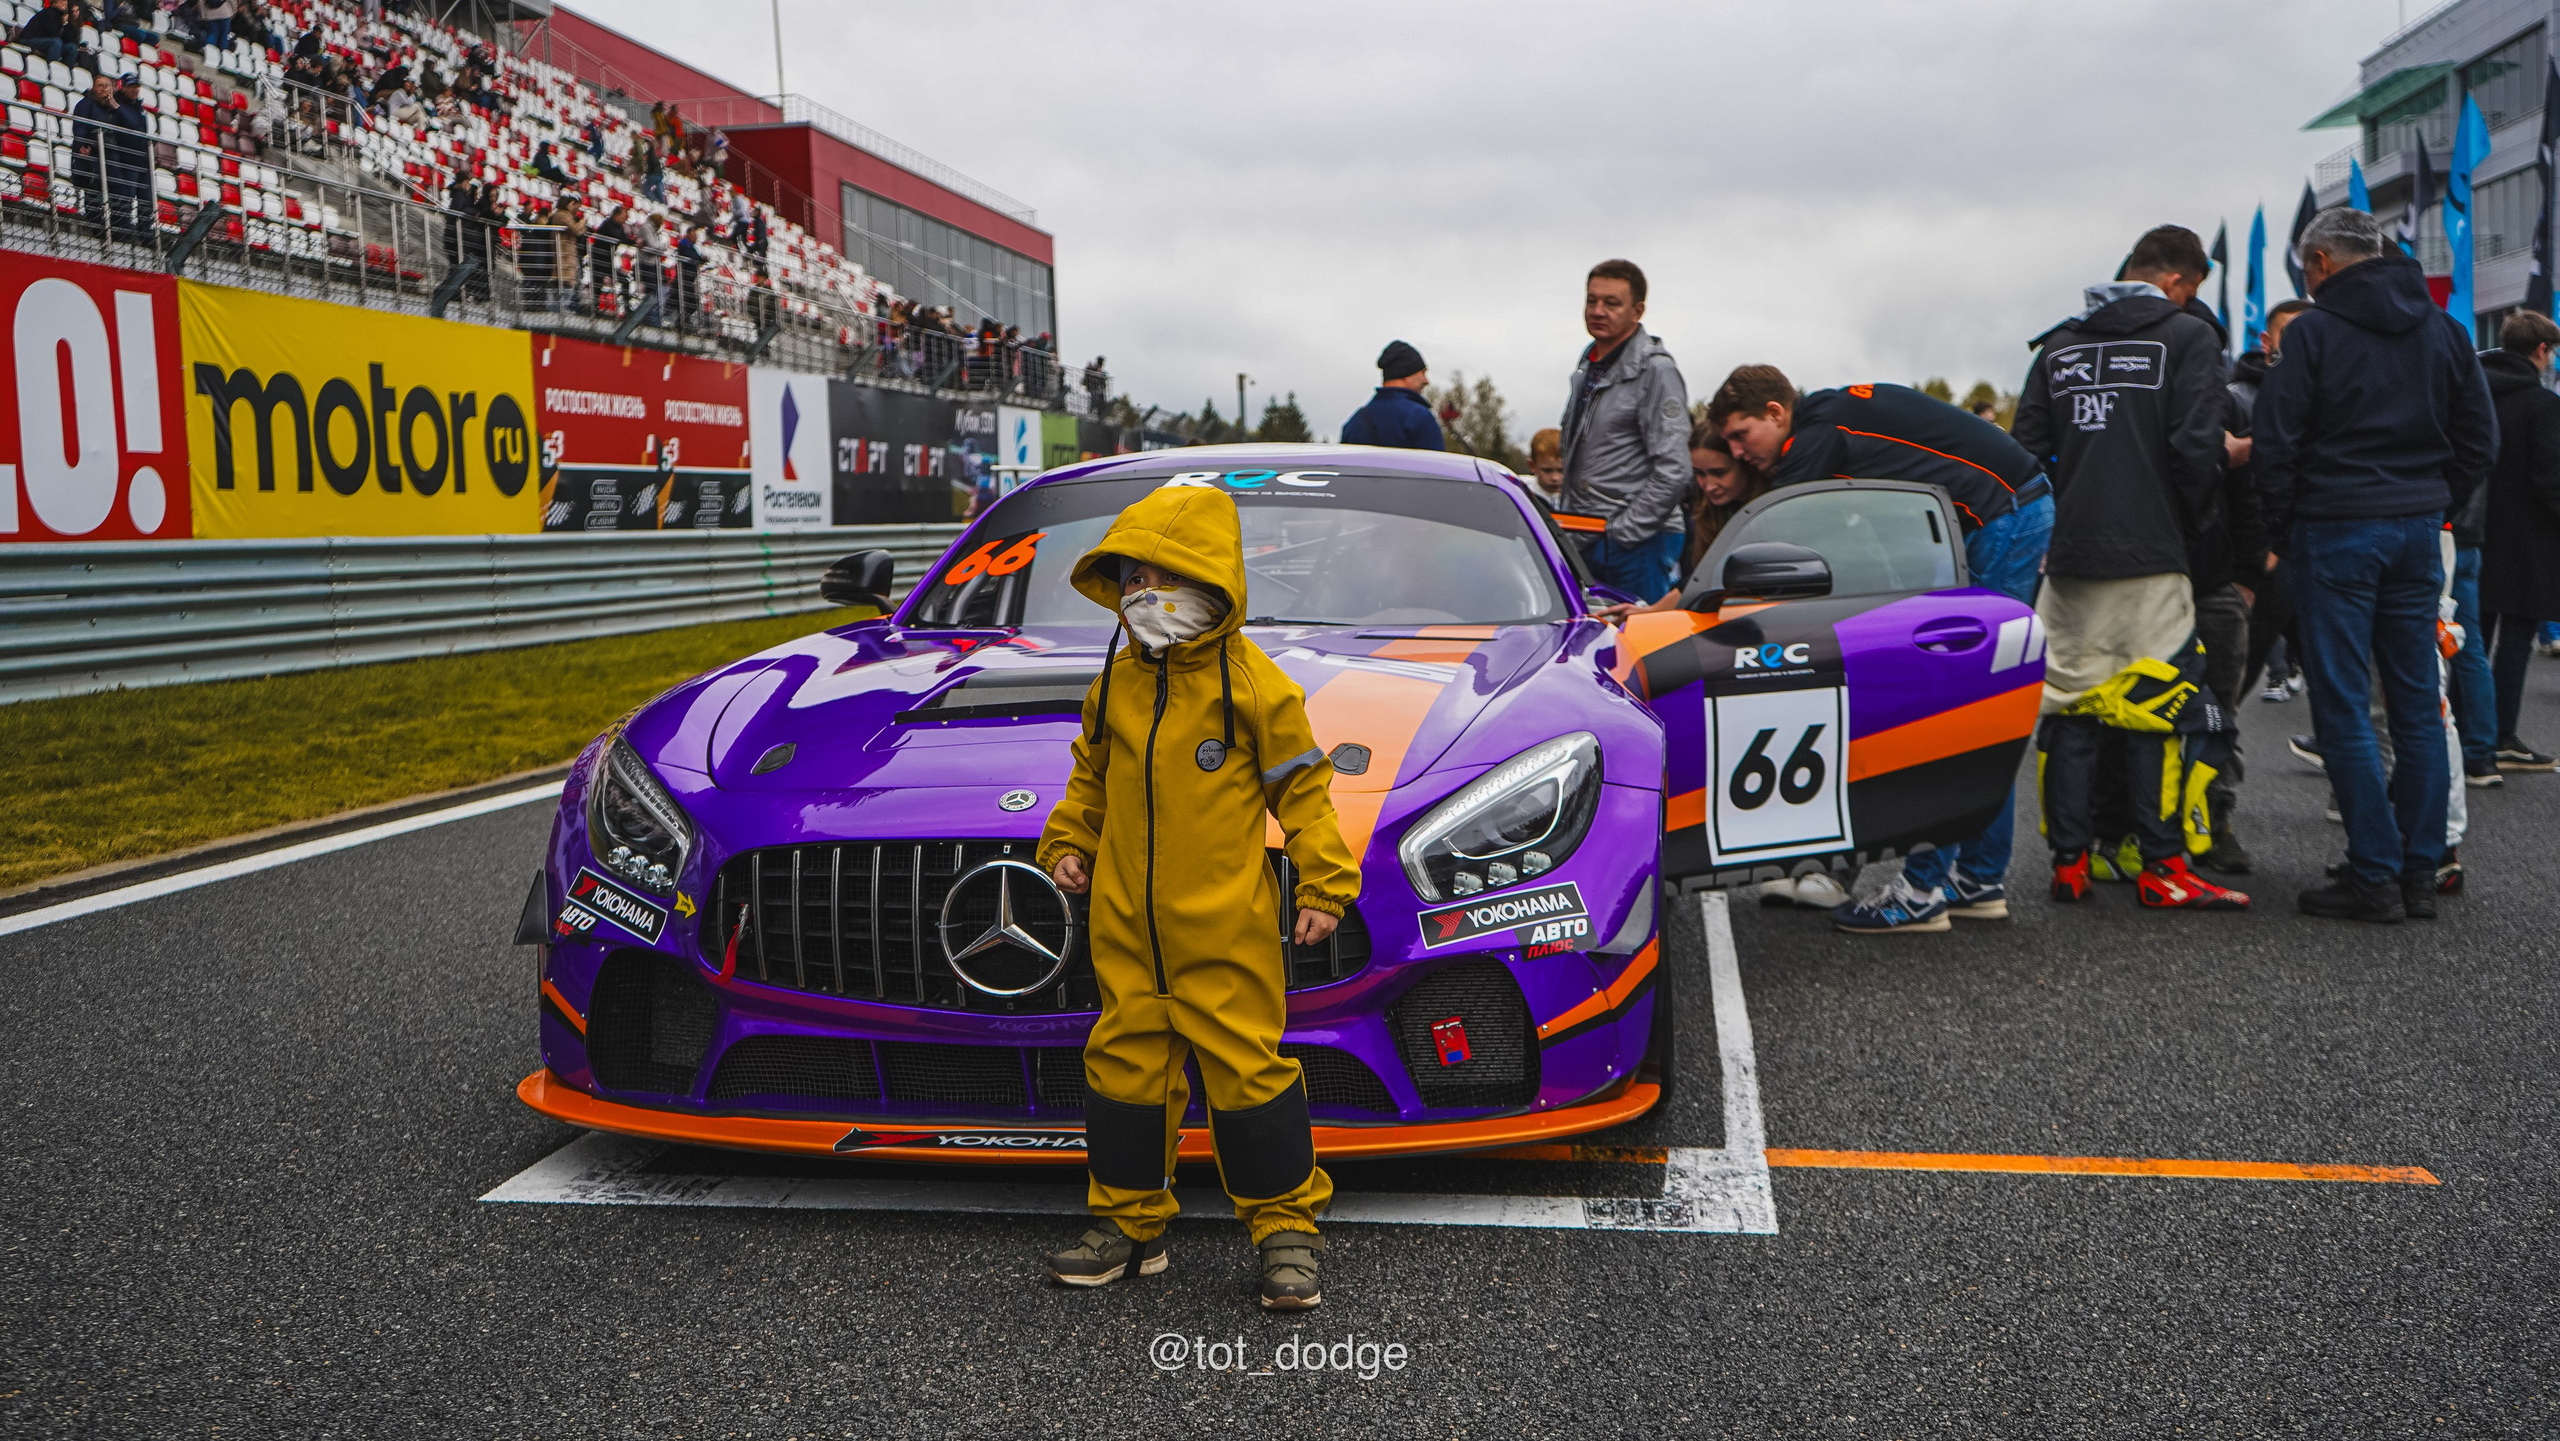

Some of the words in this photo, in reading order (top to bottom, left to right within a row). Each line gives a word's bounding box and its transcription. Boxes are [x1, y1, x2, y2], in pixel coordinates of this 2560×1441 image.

[0, 278, 166, 534] O!
[194, 361, 476, 496] motor
[493, 423, 523, 464] ru
[945, 532, 1048, 586] 66
[1729, 723, 1827, 811] 66
[559, 905, 596, 931] АВТО
[591, 886, 654, 933] YOKOHAMA
[1466, 892, 1573, 928] YOKOHAMA
[1530, 918, 1588, 945] АВТО
[1527, 938, 1574, 959] ПЛЮС
